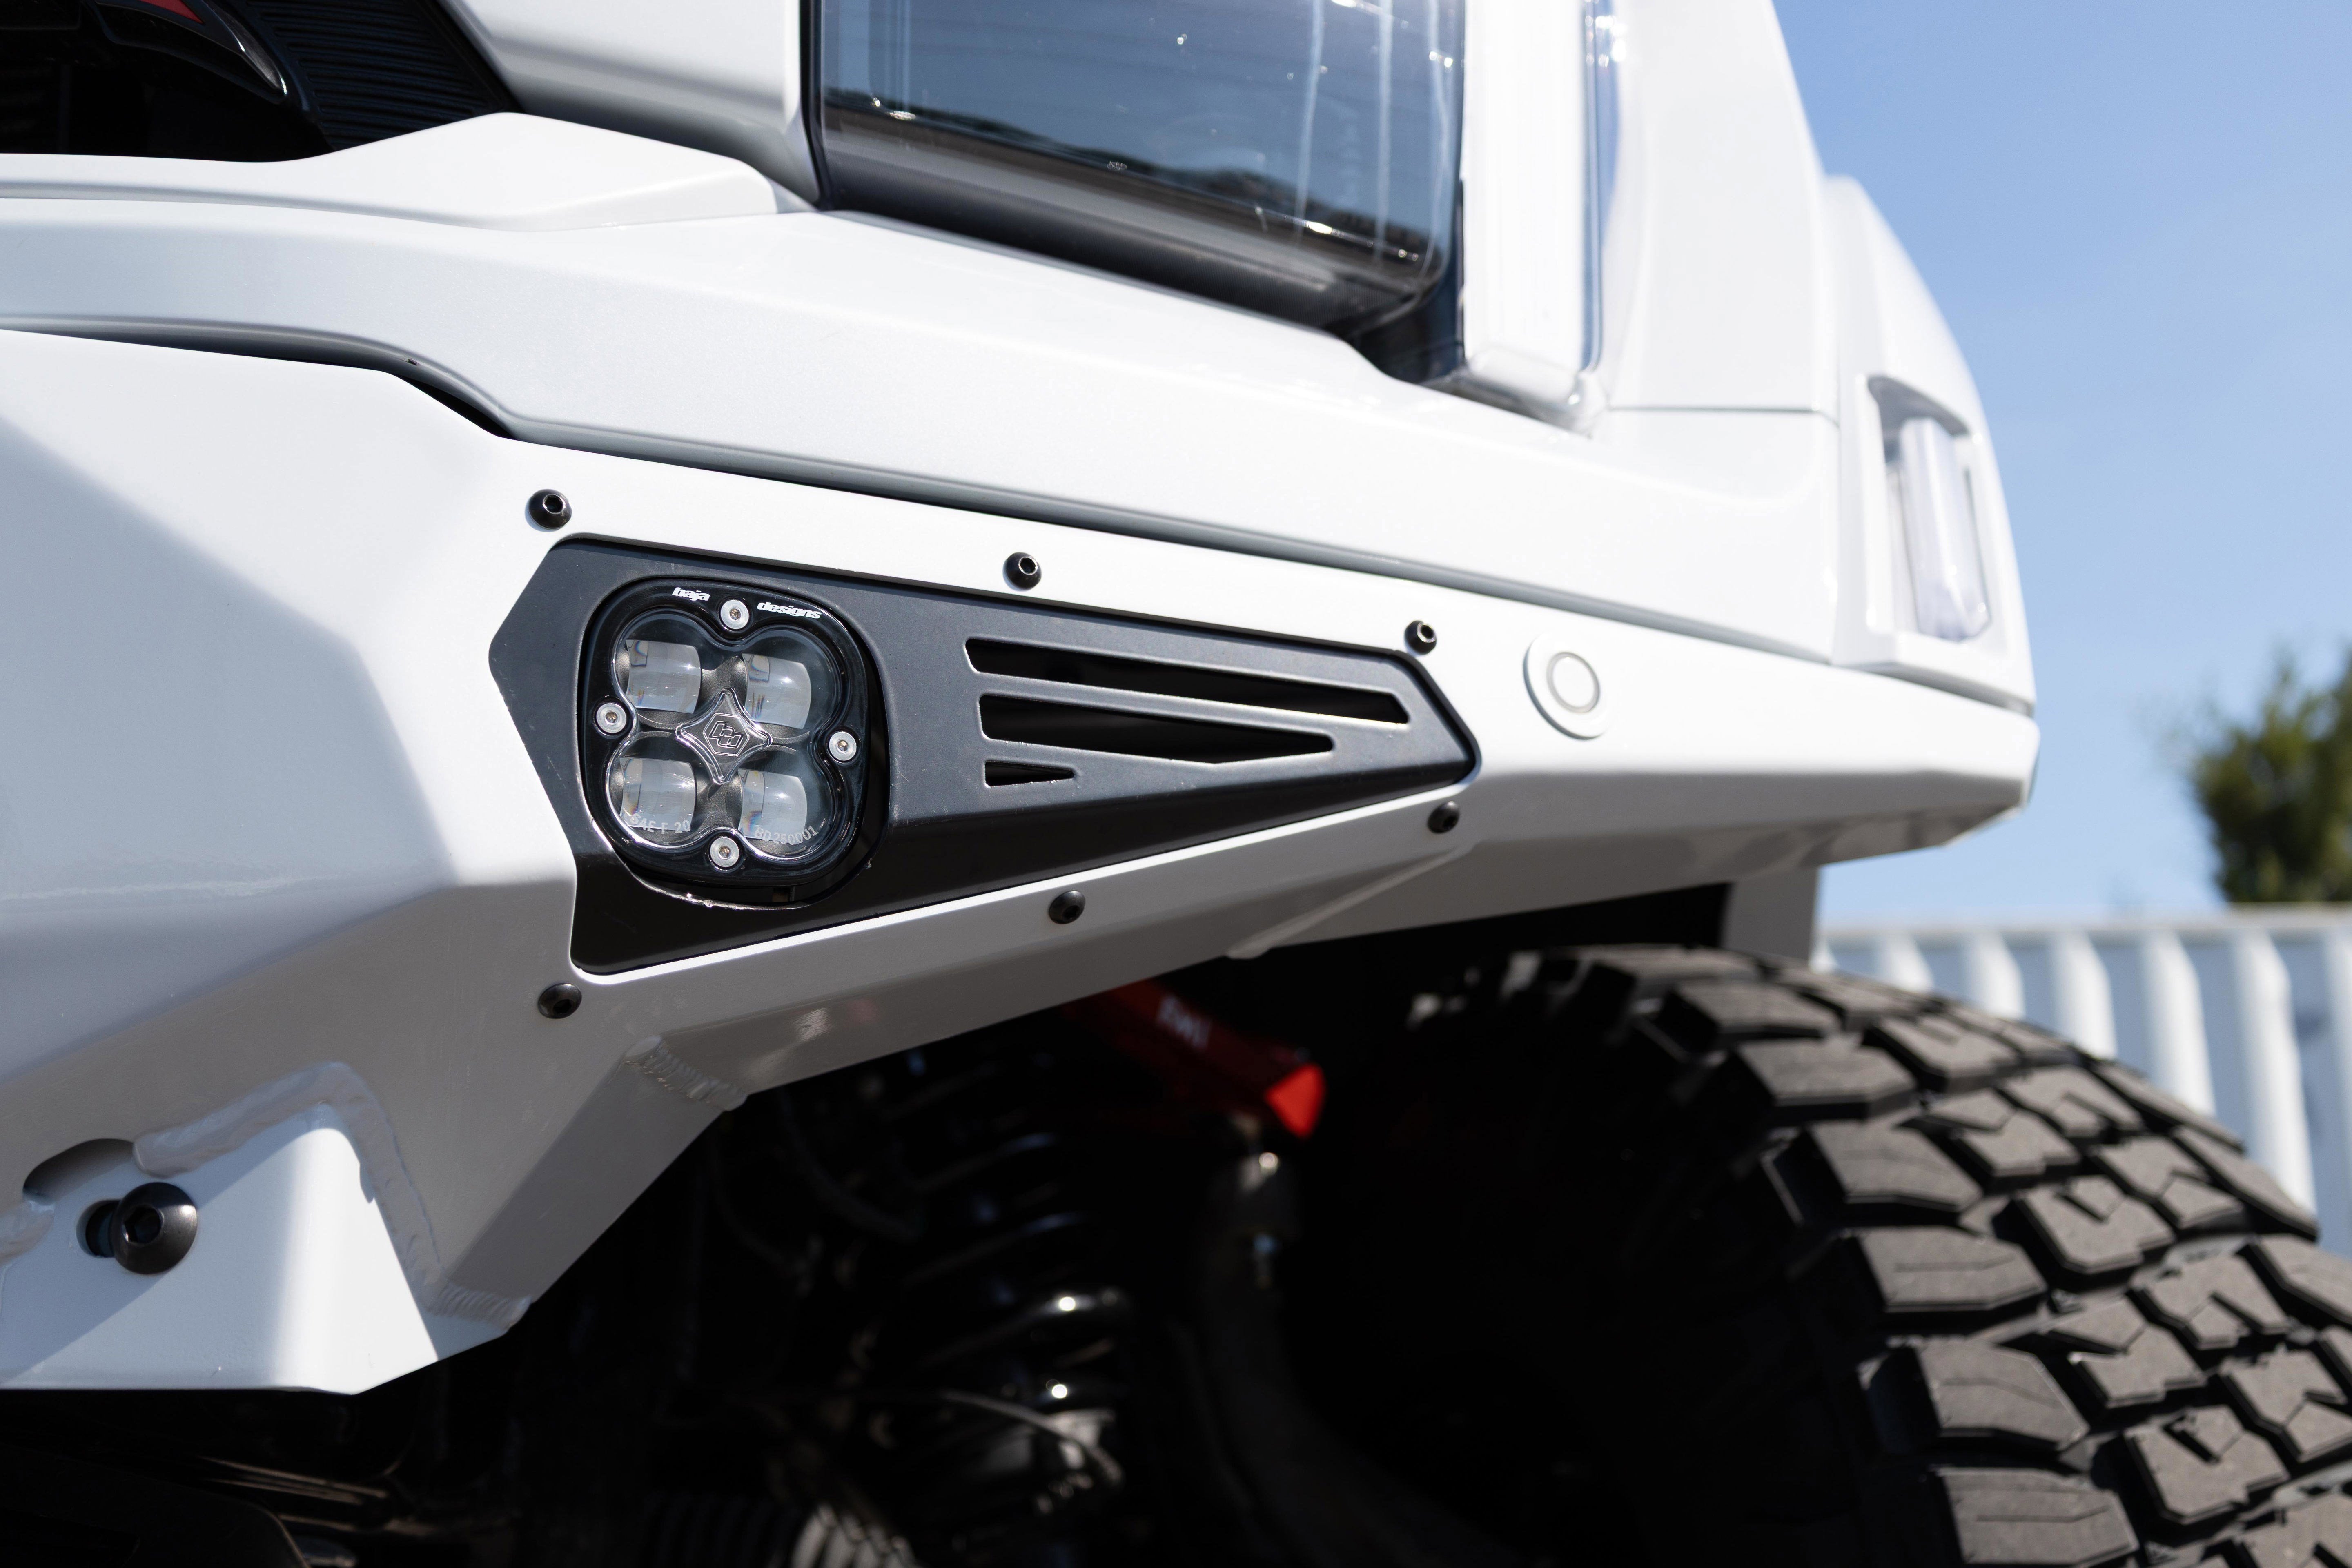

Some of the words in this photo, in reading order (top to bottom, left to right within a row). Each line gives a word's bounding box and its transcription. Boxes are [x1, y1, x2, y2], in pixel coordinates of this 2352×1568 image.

[672, 587, 710, 601] baja
[757, 602, 822, 619] designs
[630, 813, 656, 833] SAE
[661, 822, 668, 834] F
[674, 820, 691, 834] 20
